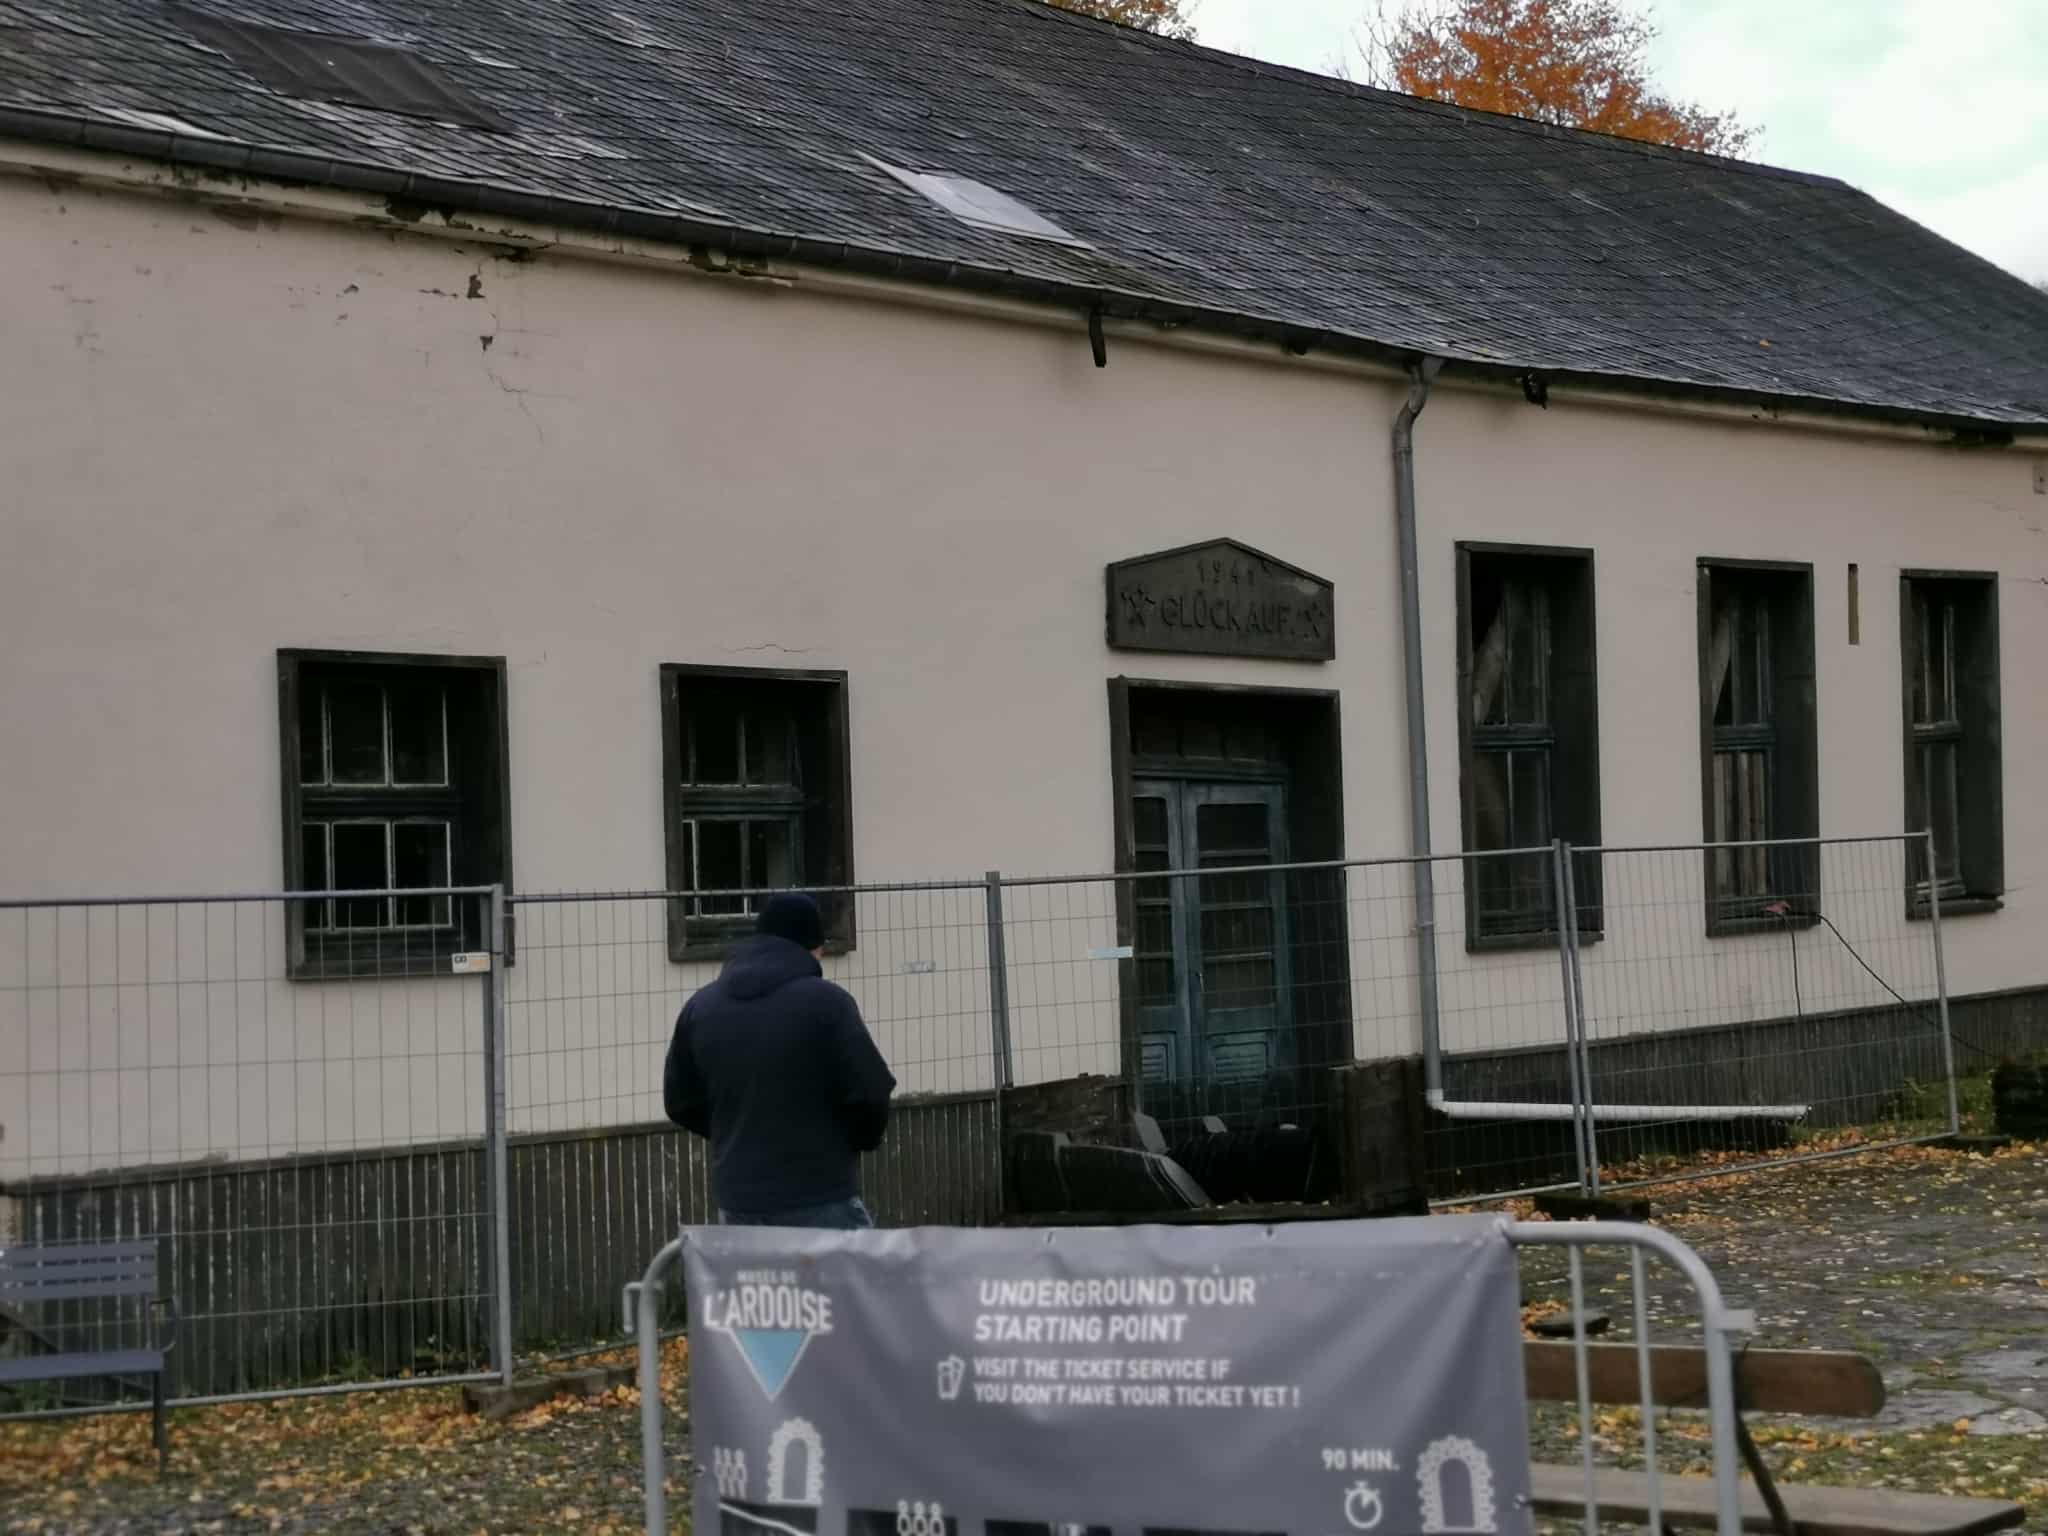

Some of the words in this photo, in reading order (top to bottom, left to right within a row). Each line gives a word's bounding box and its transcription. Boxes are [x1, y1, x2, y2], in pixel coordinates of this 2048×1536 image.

[979, 1276, 1176, 1307] UNDERGROUND
[1182, 1276, 1256, 1305] TOUR
[703, 1284, 834, 1333] L'ARDOISE
[975, 1313, 1103, 1342] STARTING
[1109, 1313, 1188, 1342] POINT
[973, 1357, 1018, 1378] VISIT
[1024, 1357, 1058, 1379] THE
[1064, 1358, 1123, 1379] TICKET
[1127, 1358, 1206, 1380] SERVICE
[1211, 1360, 1231, 1380] IF
[973, 1383, 1007, 1404] YOU
[1011, 1383, 1066, 1405] DON'T
[1069, 1386, 1115, 1406] HAVE
[1120, 1387, 1171, 1407] YOUR
[1175, 1387, 1245, 1408] TICKET
[1321, 1448, 1348, 1471] 90
[1351, 1448, 1401, 1472] MIN.
